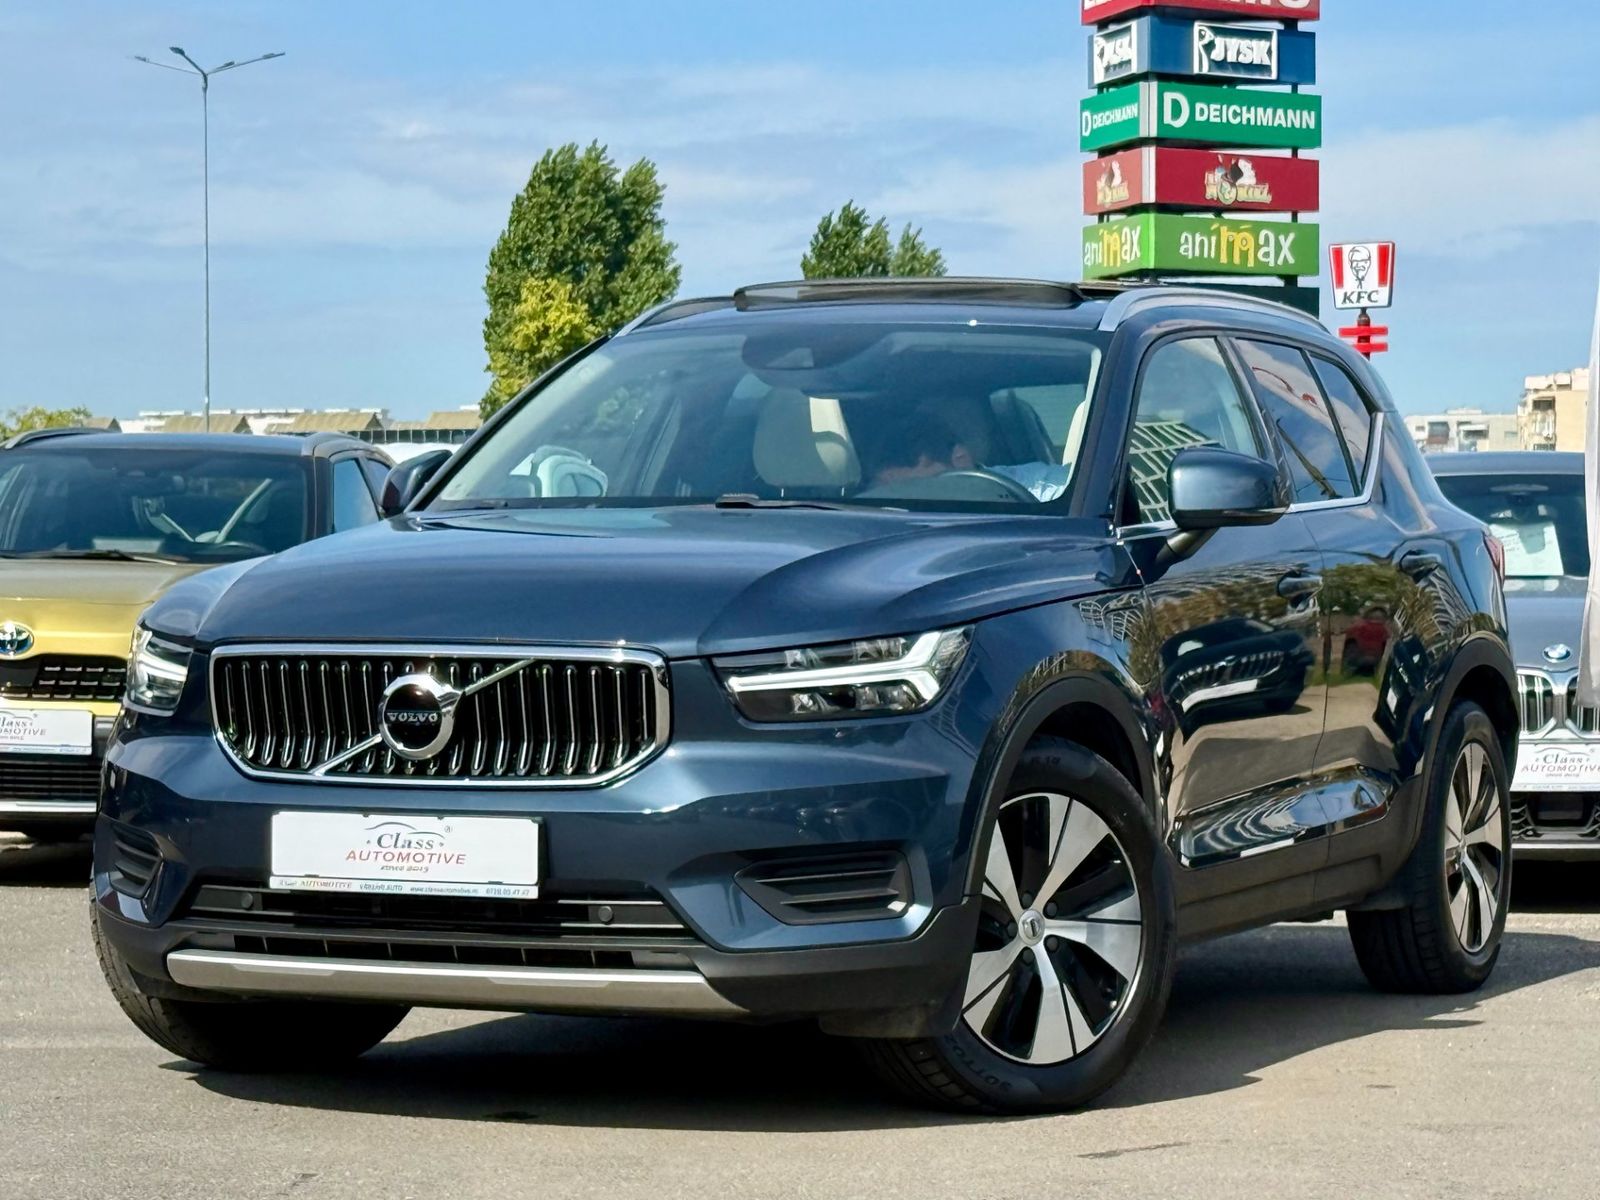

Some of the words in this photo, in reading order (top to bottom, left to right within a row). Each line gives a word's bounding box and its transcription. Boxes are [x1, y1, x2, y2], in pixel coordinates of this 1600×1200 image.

[1210, 37, 1272, 66] JYSK
[1092, 102, 1139, 130] DEICHMANN
[1195, 102, 1315, 129] DEICHMANN
[1084, 225, 1141, 267] animax
[1179, 223, 1295, 267] animax
[1341, 290, 1379, 304] KFC
[0, 716, 28, 727] lass
[387, 712, 438, 722] VOLVO
[376, 832, 434, 849] Class
[346, 850, 467, 864] AUTOMOTIVE
